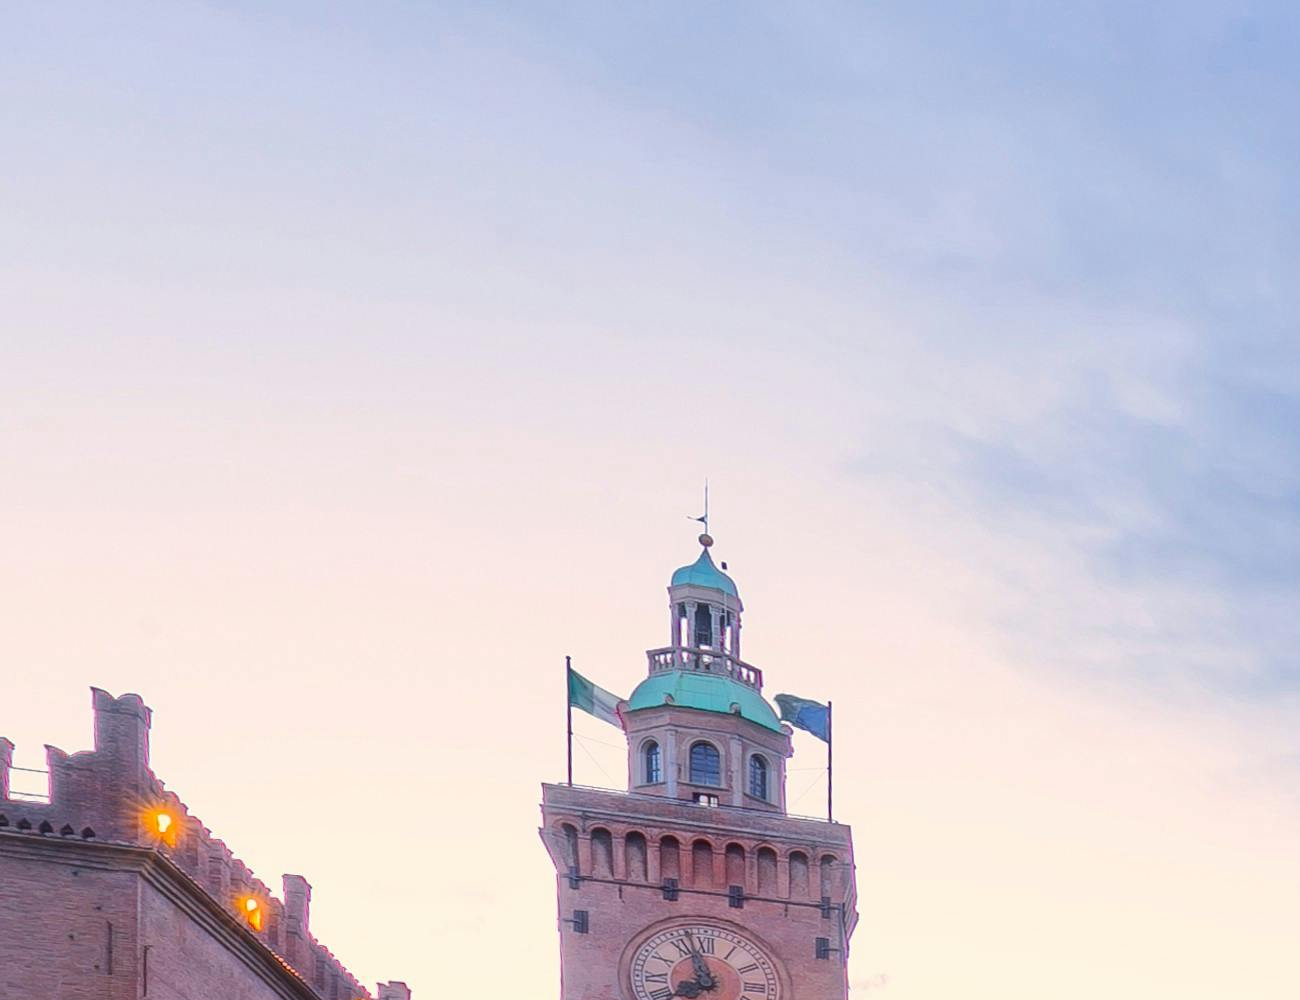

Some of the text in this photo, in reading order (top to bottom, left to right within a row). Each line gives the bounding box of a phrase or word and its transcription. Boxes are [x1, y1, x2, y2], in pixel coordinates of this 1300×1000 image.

[670, 939, 692, 957] XI
[651, 951, 675, 968] X
[738, 963, 759, 975] II
[644, 971, 668, 984] IX
[743, 982, 766, 993] III
